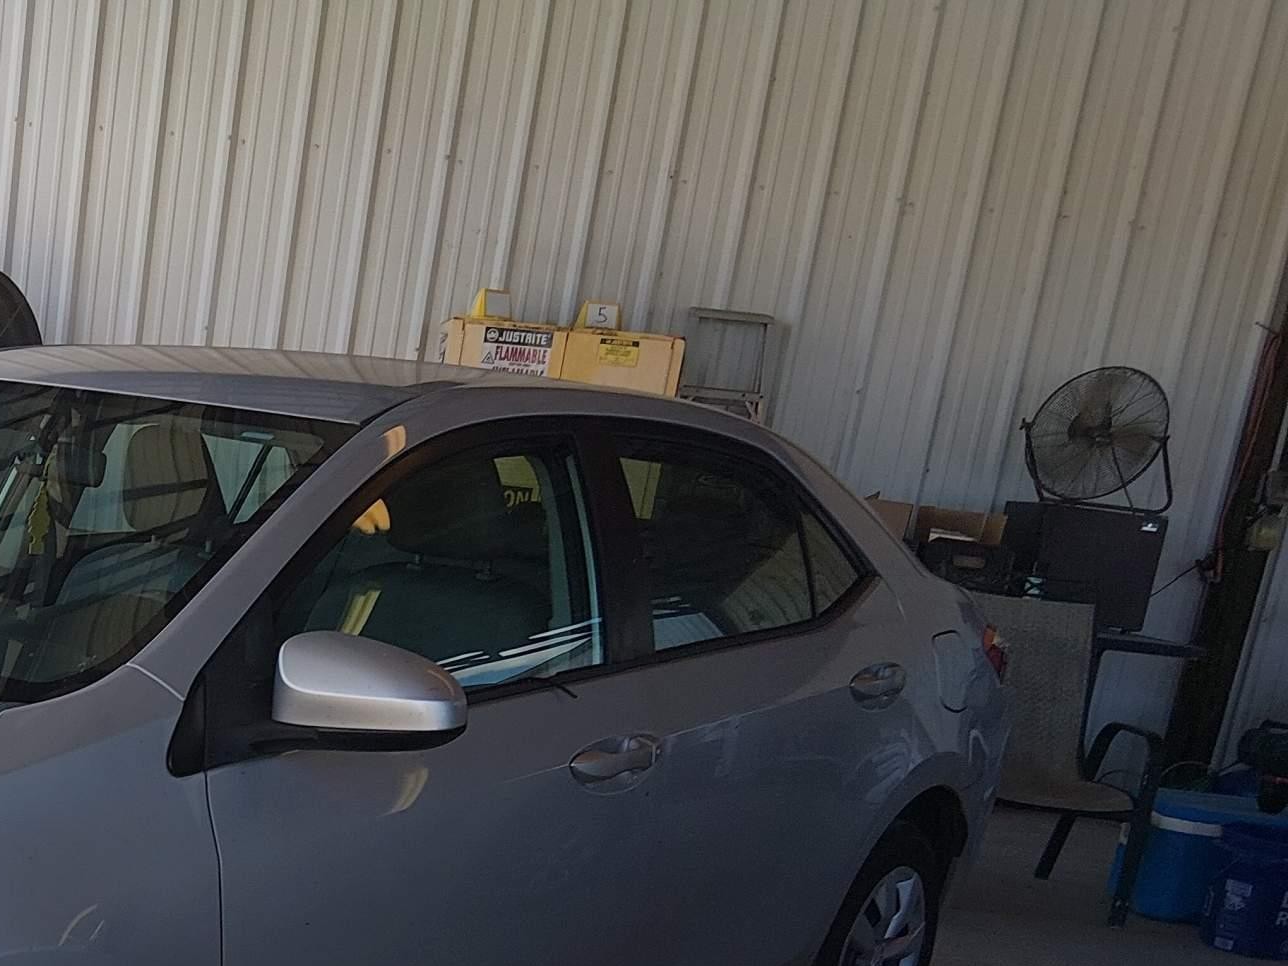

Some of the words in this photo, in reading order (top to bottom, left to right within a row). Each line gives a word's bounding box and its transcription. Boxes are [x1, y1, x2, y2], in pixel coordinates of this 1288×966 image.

[594, 305, 608, 324] 5
[498, 330, 549, 345] JUSTRITE
[494, 345, 548, 365] FLAMMABLE
